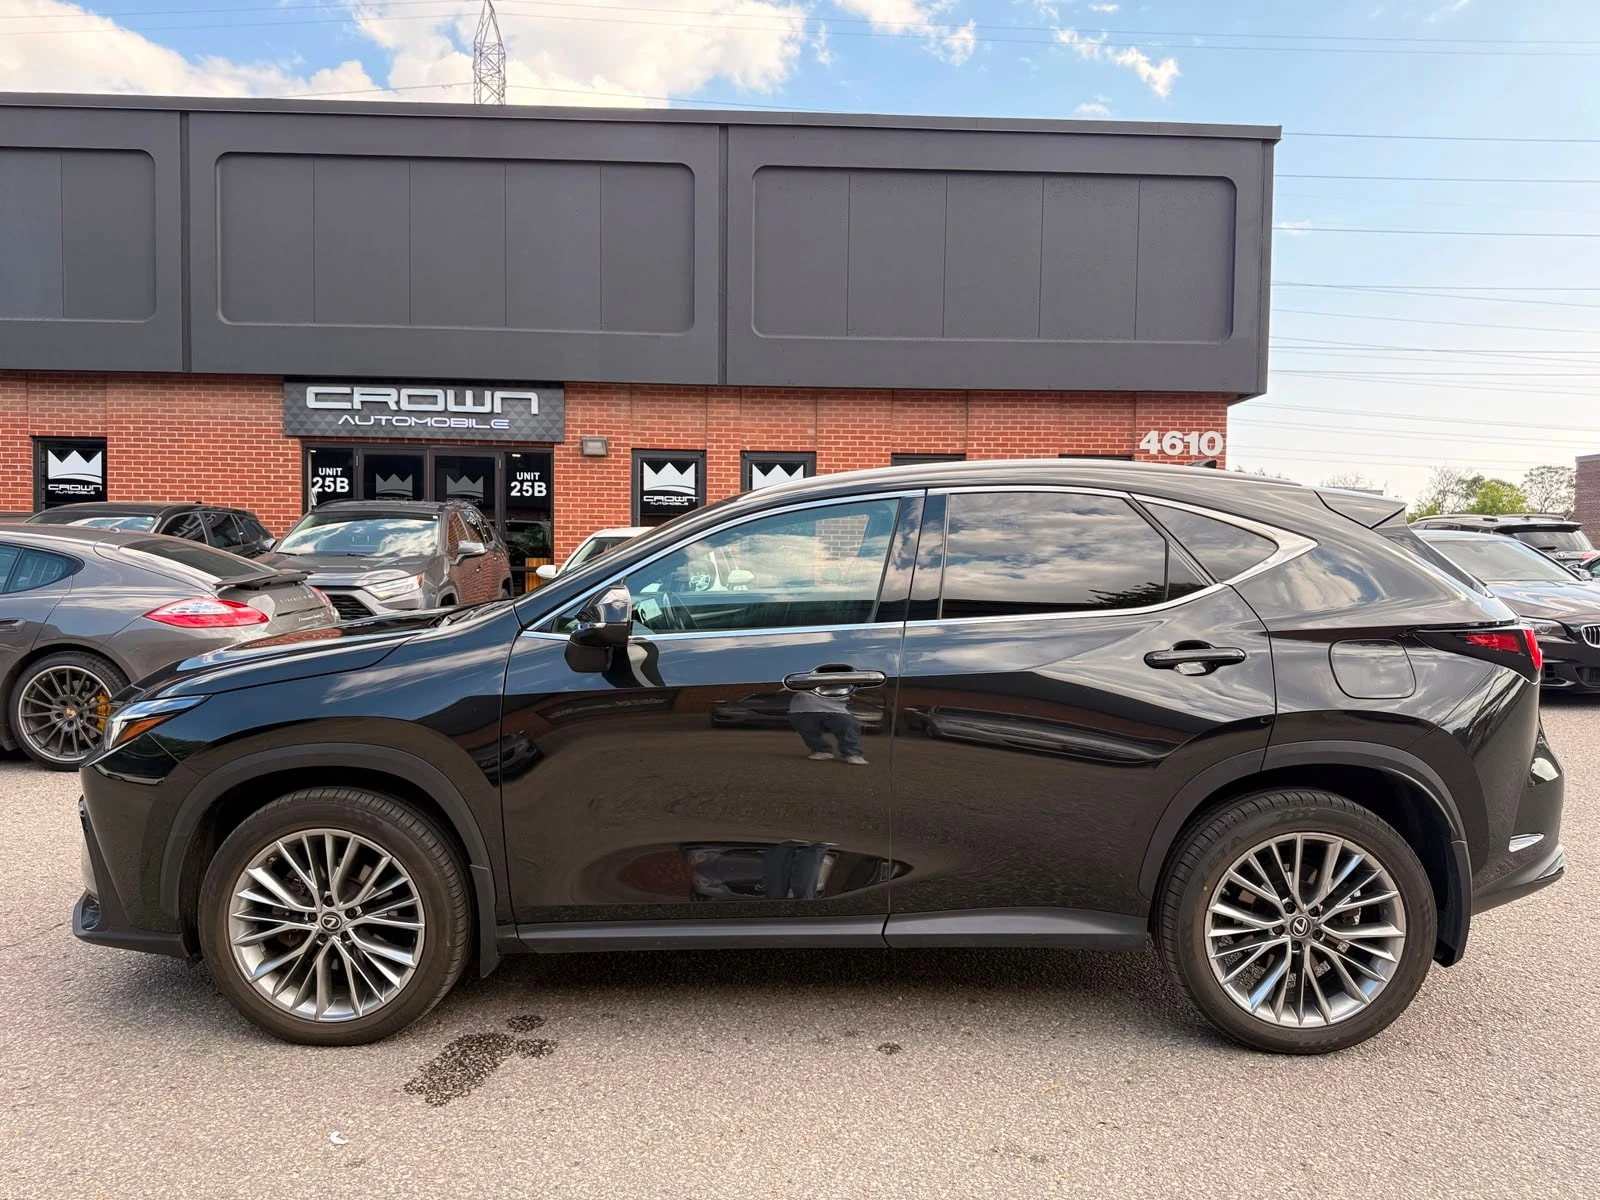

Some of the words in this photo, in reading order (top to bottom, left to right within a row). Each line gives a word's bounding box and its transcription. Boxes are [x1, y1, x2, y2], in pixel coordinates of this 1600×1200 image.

[306, 386, 539, 415] CROWN
[338, 414, 510, 430] AUTOMOBILE
[1140, 430, 1224, 457] 4610
[318, 467, 342, 476] UNIT
[516, 471, 541, 481] UNIT
[47, 483, 103, 492] CROWN
[312, 476, 349, 493] 25B
[510, 481, 547, 497] 25B
[643, 495, 696, 503] CROWN
